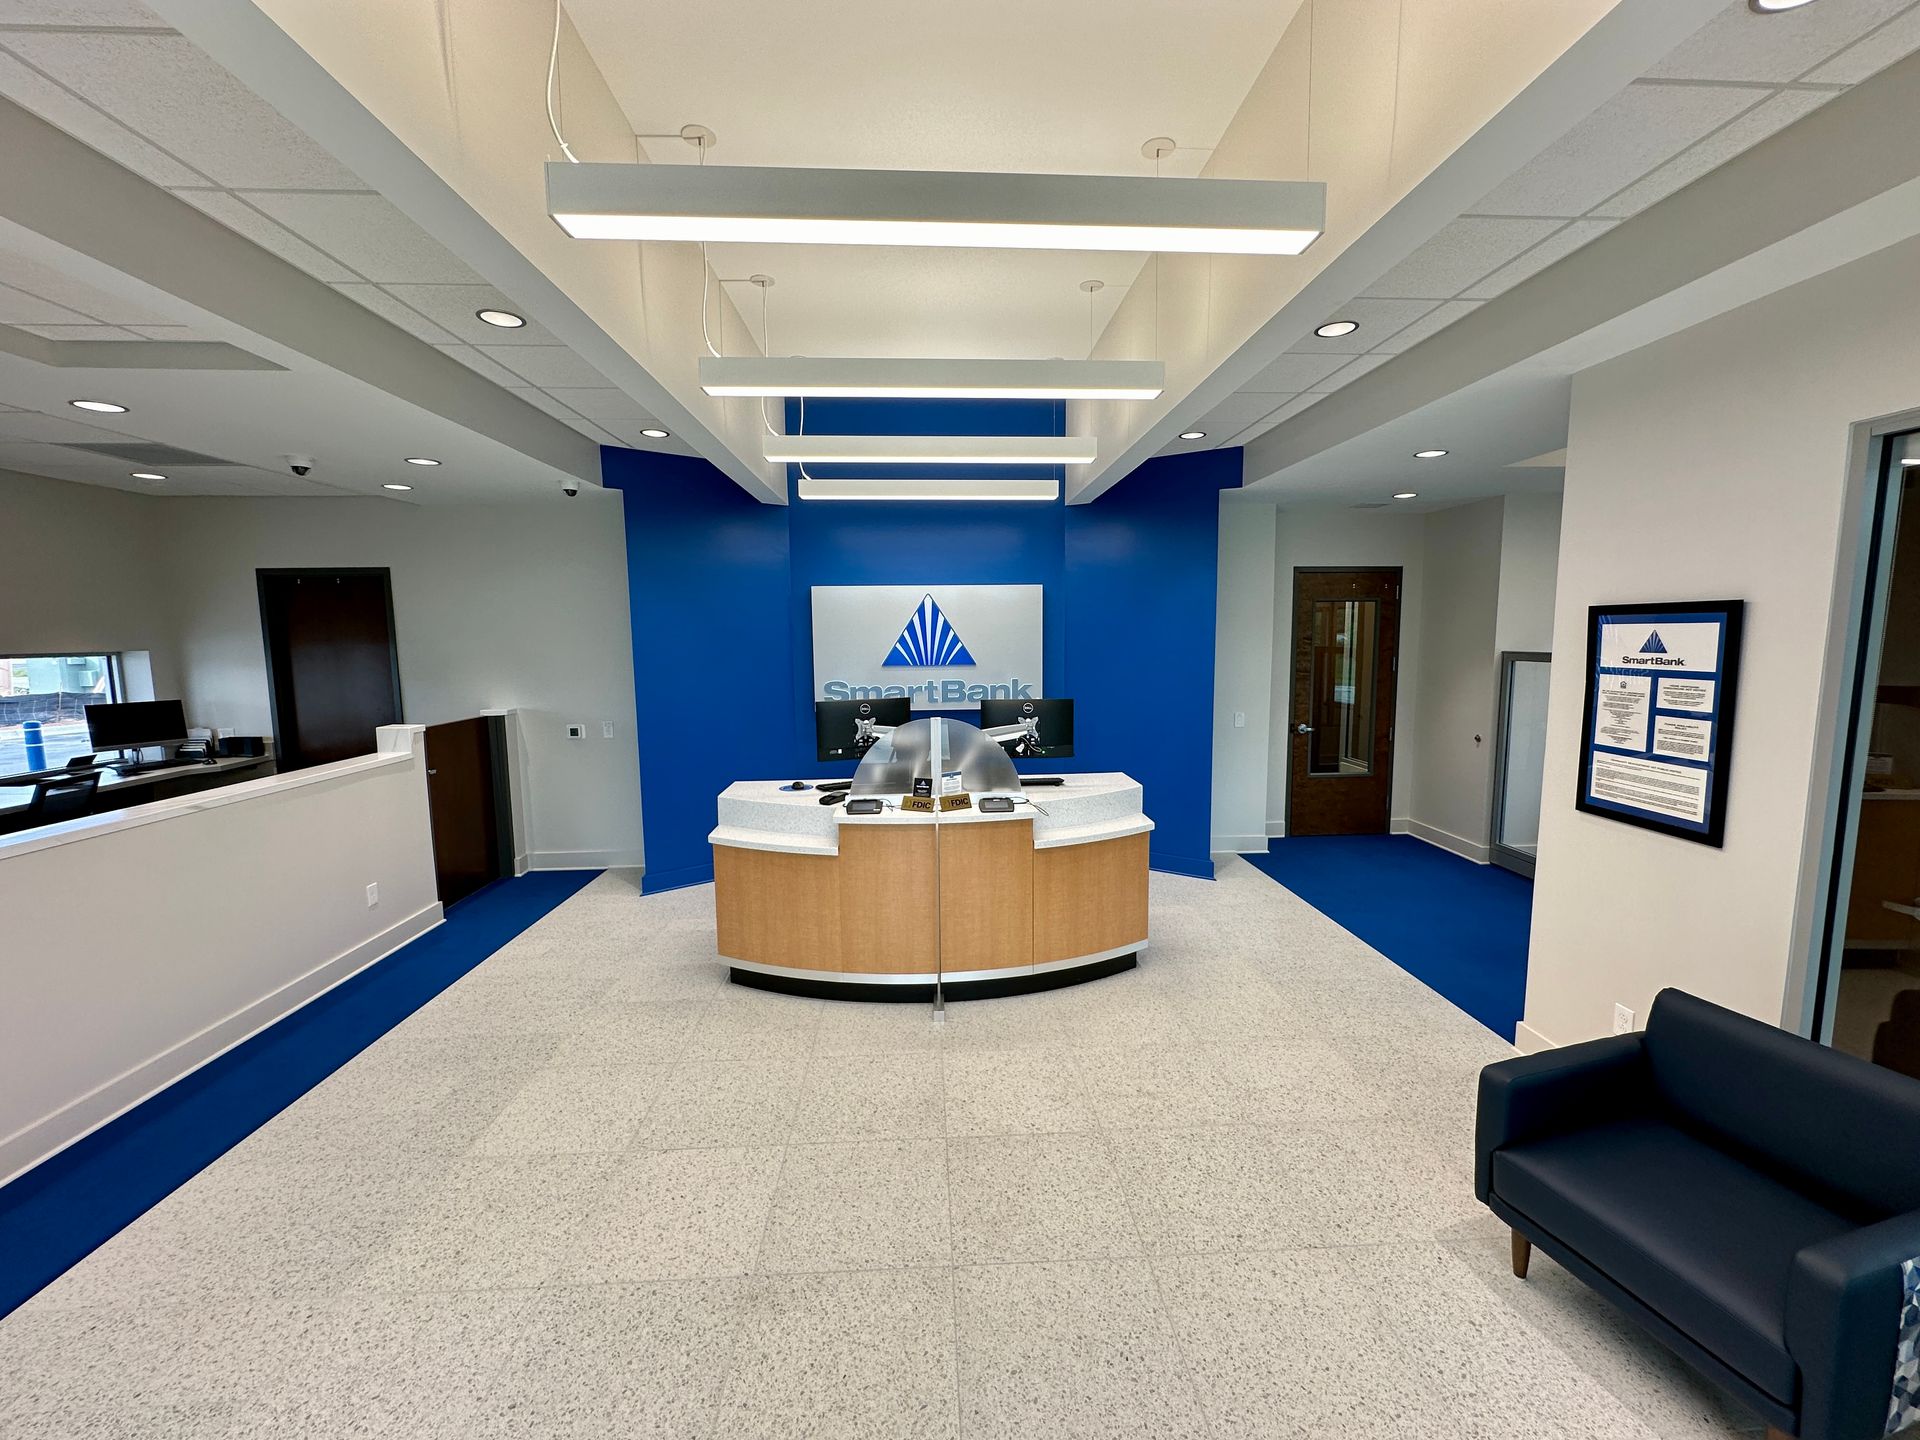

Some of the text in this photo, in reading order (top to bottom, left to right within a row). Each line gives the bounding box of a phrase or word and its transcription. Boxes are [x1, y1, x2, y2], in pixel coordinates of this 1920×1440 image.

[1622, 655, 1685, 666] SmartBank
[823, 678, 1033, 704] SmartBank
[912, 801, 931, 809] FDIC
[951, 797, 969, 807] FDIC
